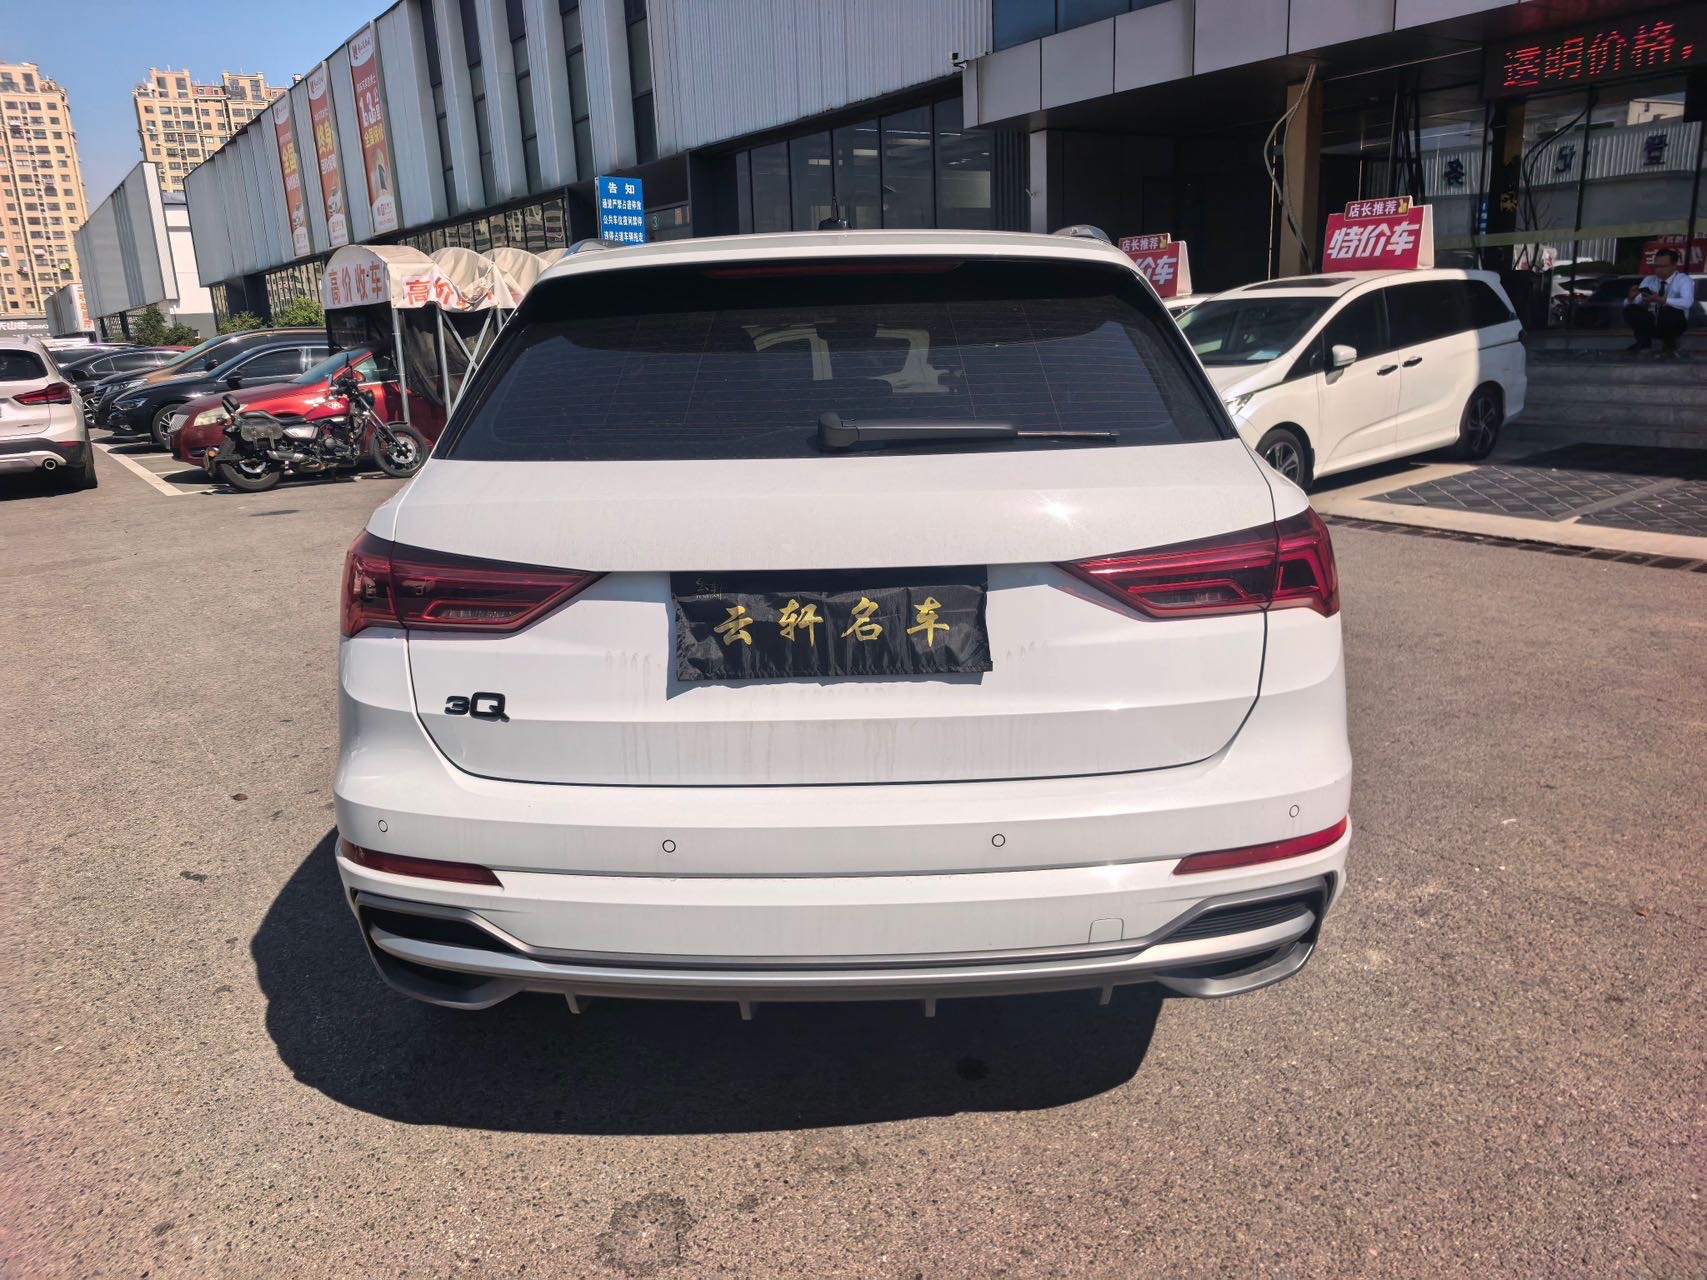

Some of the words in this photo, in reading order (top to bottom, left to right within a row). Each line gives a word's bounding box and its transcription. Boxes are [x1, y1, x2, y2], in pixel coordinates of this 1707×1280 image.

[608, 182, 635, 195] 告知
[1349, 200, 1398, 217] 店长推荐
[1122, 237, 1159, 252] 店长推荐
[1327, 221, 1420, 259] 特价车
[328, 261, 383, 305] 高价收车
[1136, 255, 1178, 285] 价车
[713, 596, 950, 647] 云轩名车
[444, 692, 510, 722] 3Q
